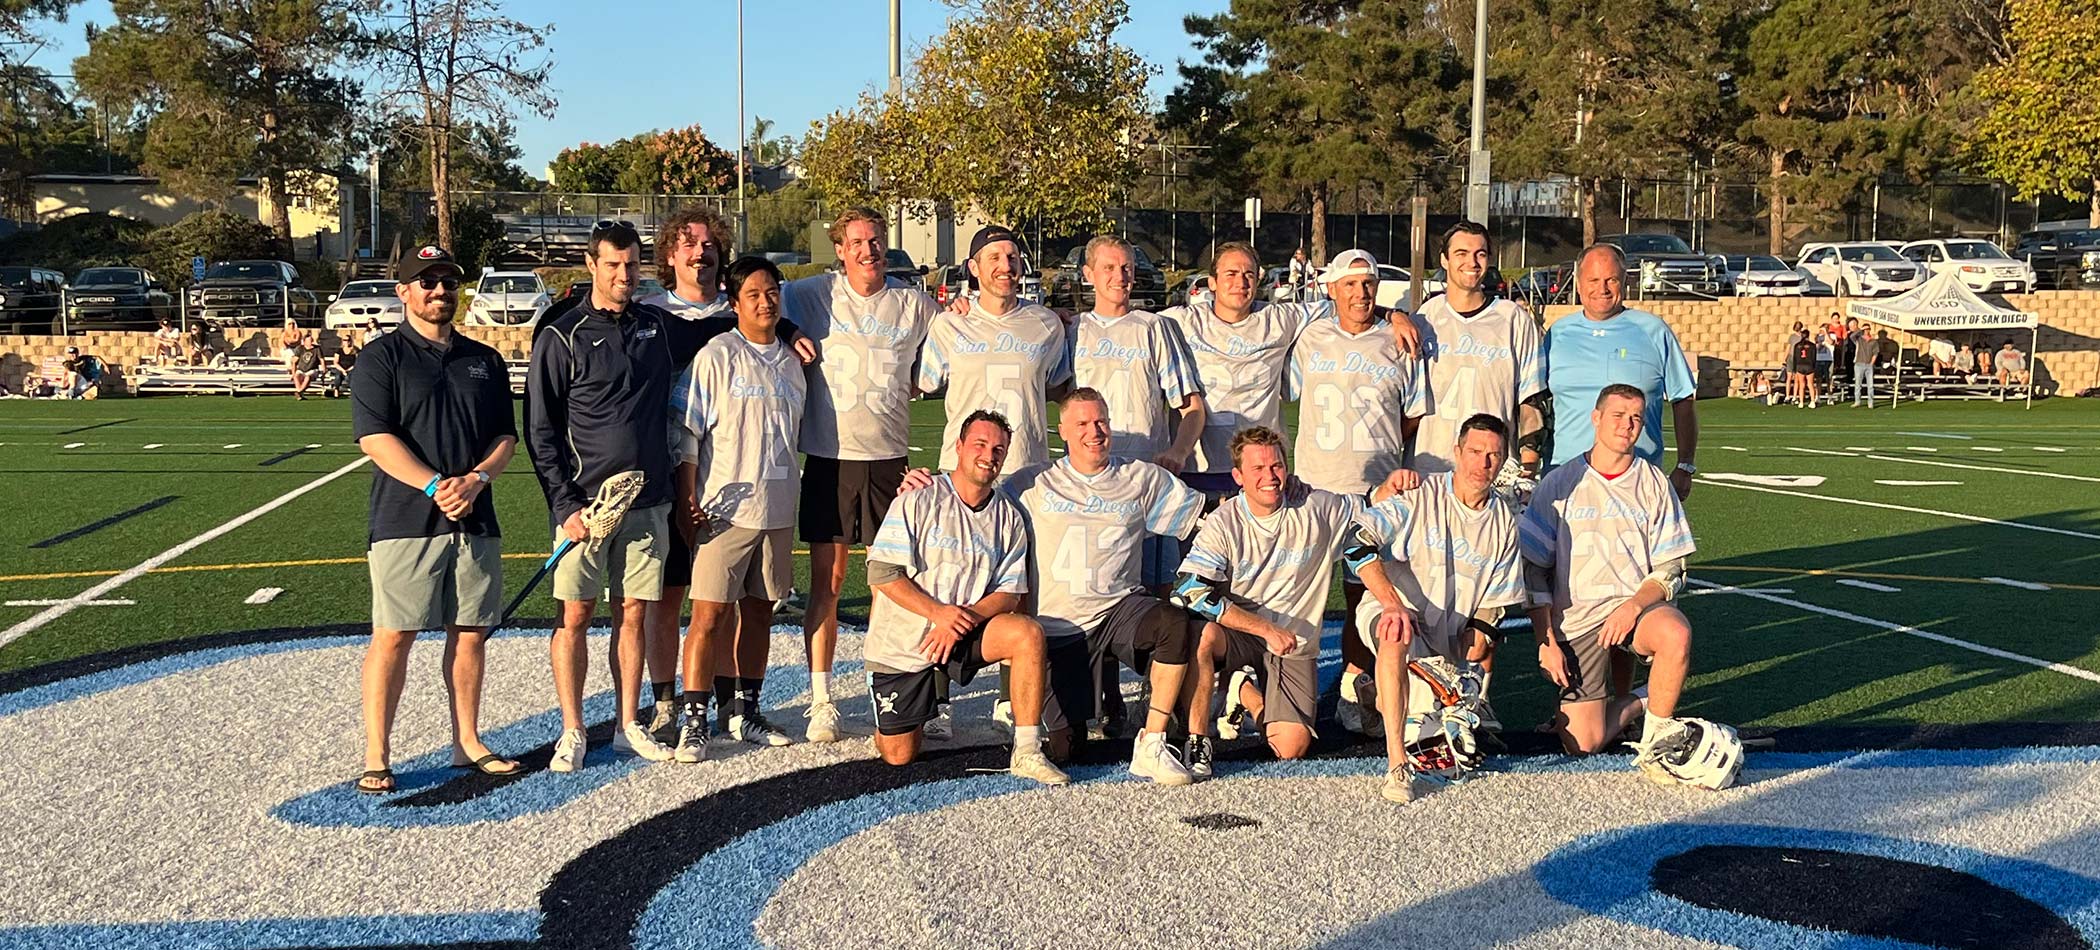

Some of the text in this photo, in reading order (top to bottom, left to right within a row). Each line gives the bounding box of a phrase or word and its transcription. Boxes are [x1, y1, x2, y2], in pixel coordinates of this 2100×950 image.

[1914, 313, 2028, 326] UNIVERSITY OF SAN DIEGO
[1929, 300, 1959, 309] USD
[856, 314, 912, 346] Diego
[953, 332, 988, 354] San
[994, 332, 1049, 362] Diego
[1092, 338, 1150, 367] Diego
[1455, 332, 1510, 366] Diego
[823, 343, 899, 415] 35
[1309, 350, 1399, 384] San Diego
[731, 376, 768, 399] San
[980, 362, 1024, 432] 5
[1440, 366, 1479, 432] 4
[1313, 382, 1386, 452] 32
[1040, 490, 1141, 524] San Diego
[926, 526, 960, 550] San
[1425, 527, 1492, 577] Sa Dieg
[1270, 542, 1318, 571] Dieg
